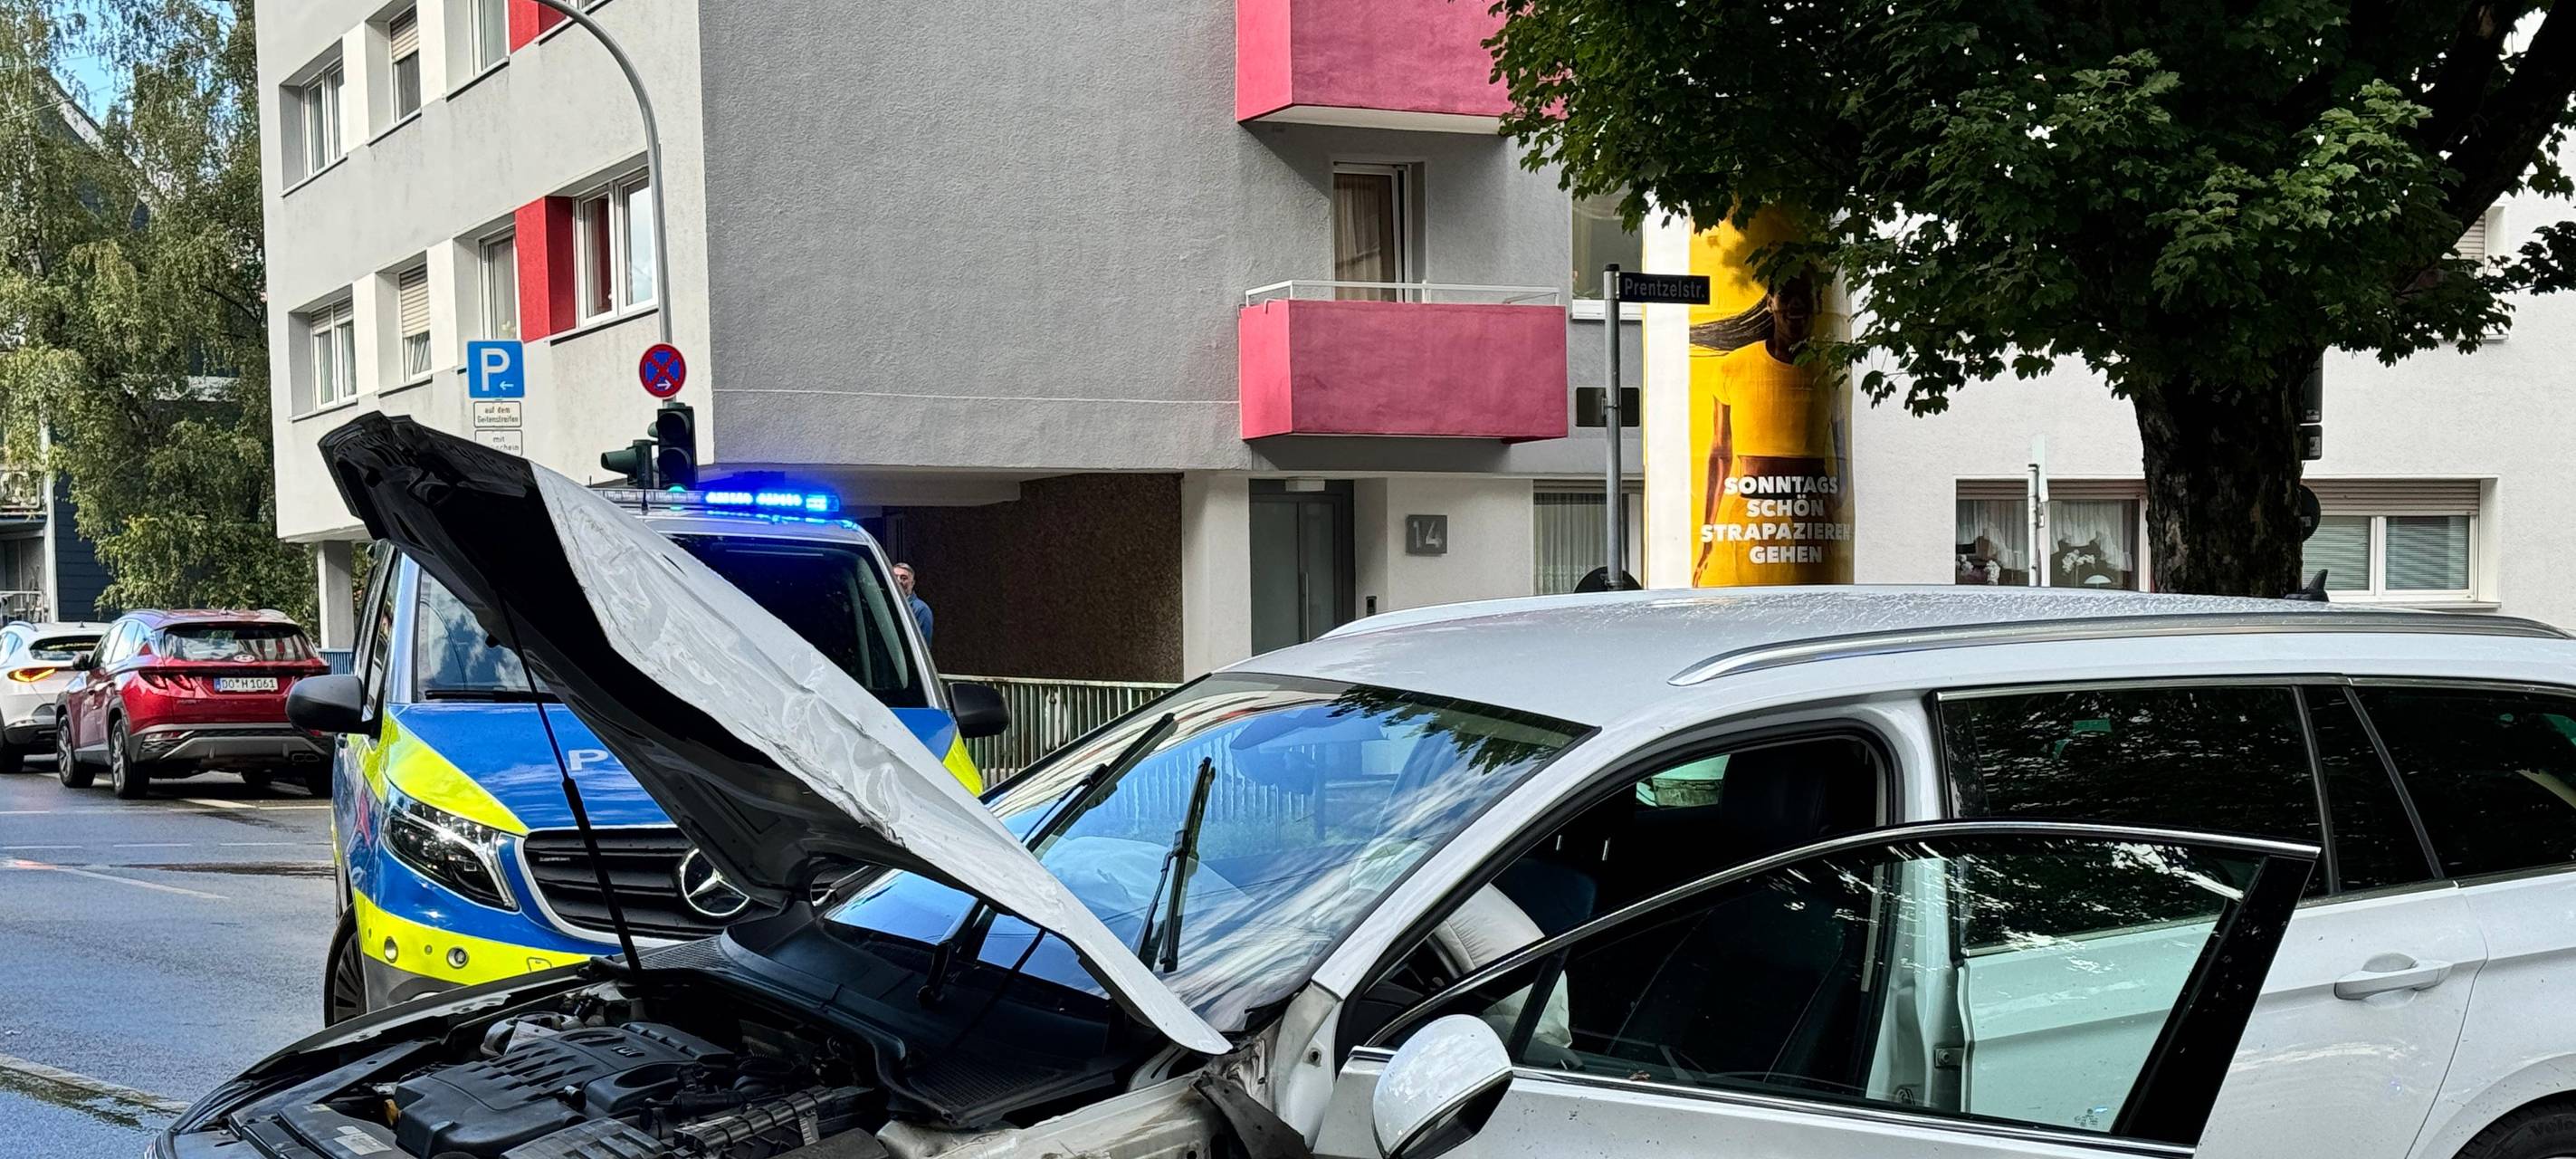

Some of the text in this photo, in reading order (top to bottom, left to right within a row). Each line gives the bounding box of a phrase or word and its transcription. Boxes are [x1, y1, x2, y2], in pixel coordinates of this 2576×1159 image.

[1624, 277, 1705, 298] Prentzelstr.
[481, 348, 510, 391] P
[477, 415, 519, 423] Seitenstreifen
[497, 406, 510, 414] dem
[1724, 475, 1838, 494] SONNTAGS
[1746, 493, 1824, 517] SCHÖN
[1413, 521, 1443, 549] 14
[1749, 546, 1823, 564] GEHEN
